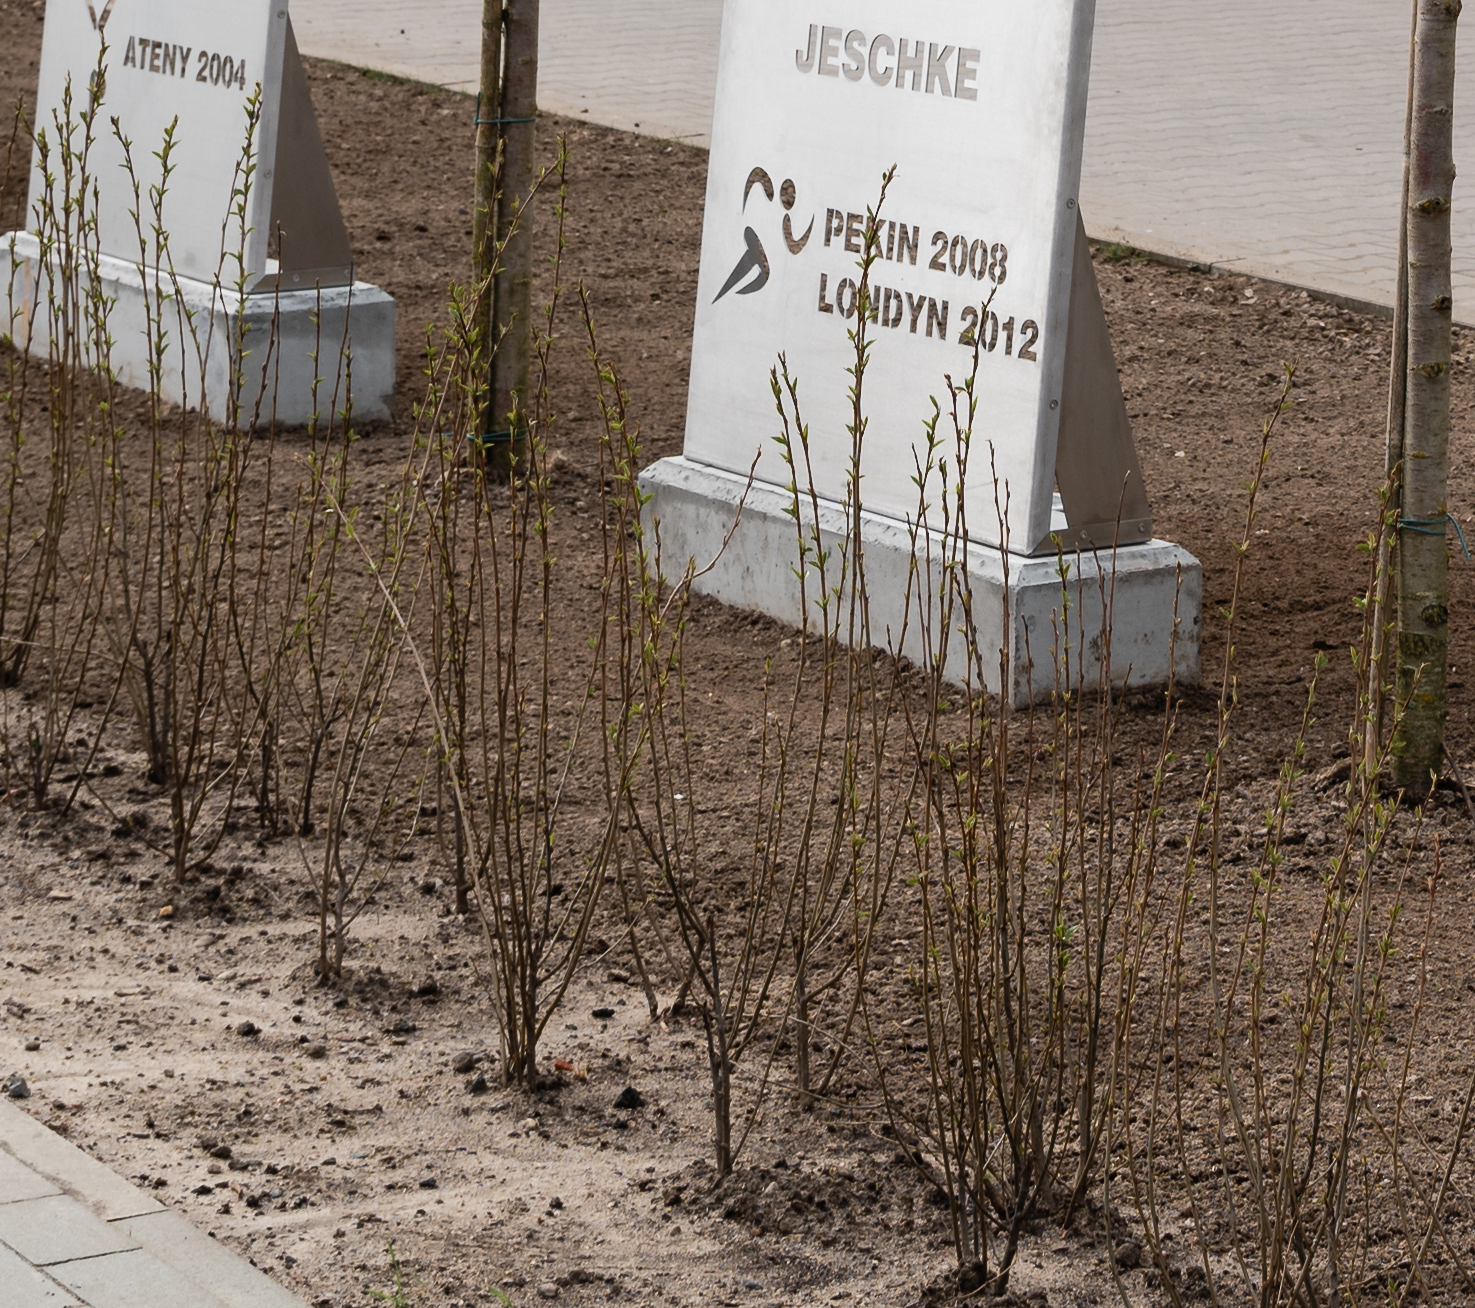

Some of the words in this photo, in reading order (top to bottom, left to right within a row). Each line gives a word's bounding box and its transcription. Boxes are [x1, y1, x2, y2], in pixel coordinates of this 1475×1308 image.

[122, 34, 193, 80] ATENY
[197, 49, 248, 92] 2004
[795, 22, 982, 102] JESCHKE
[824, 206, 921, 267] PEKIN
[929, 228, 1009, 285] 2008
[958, 303, 1040, 363] 2012
